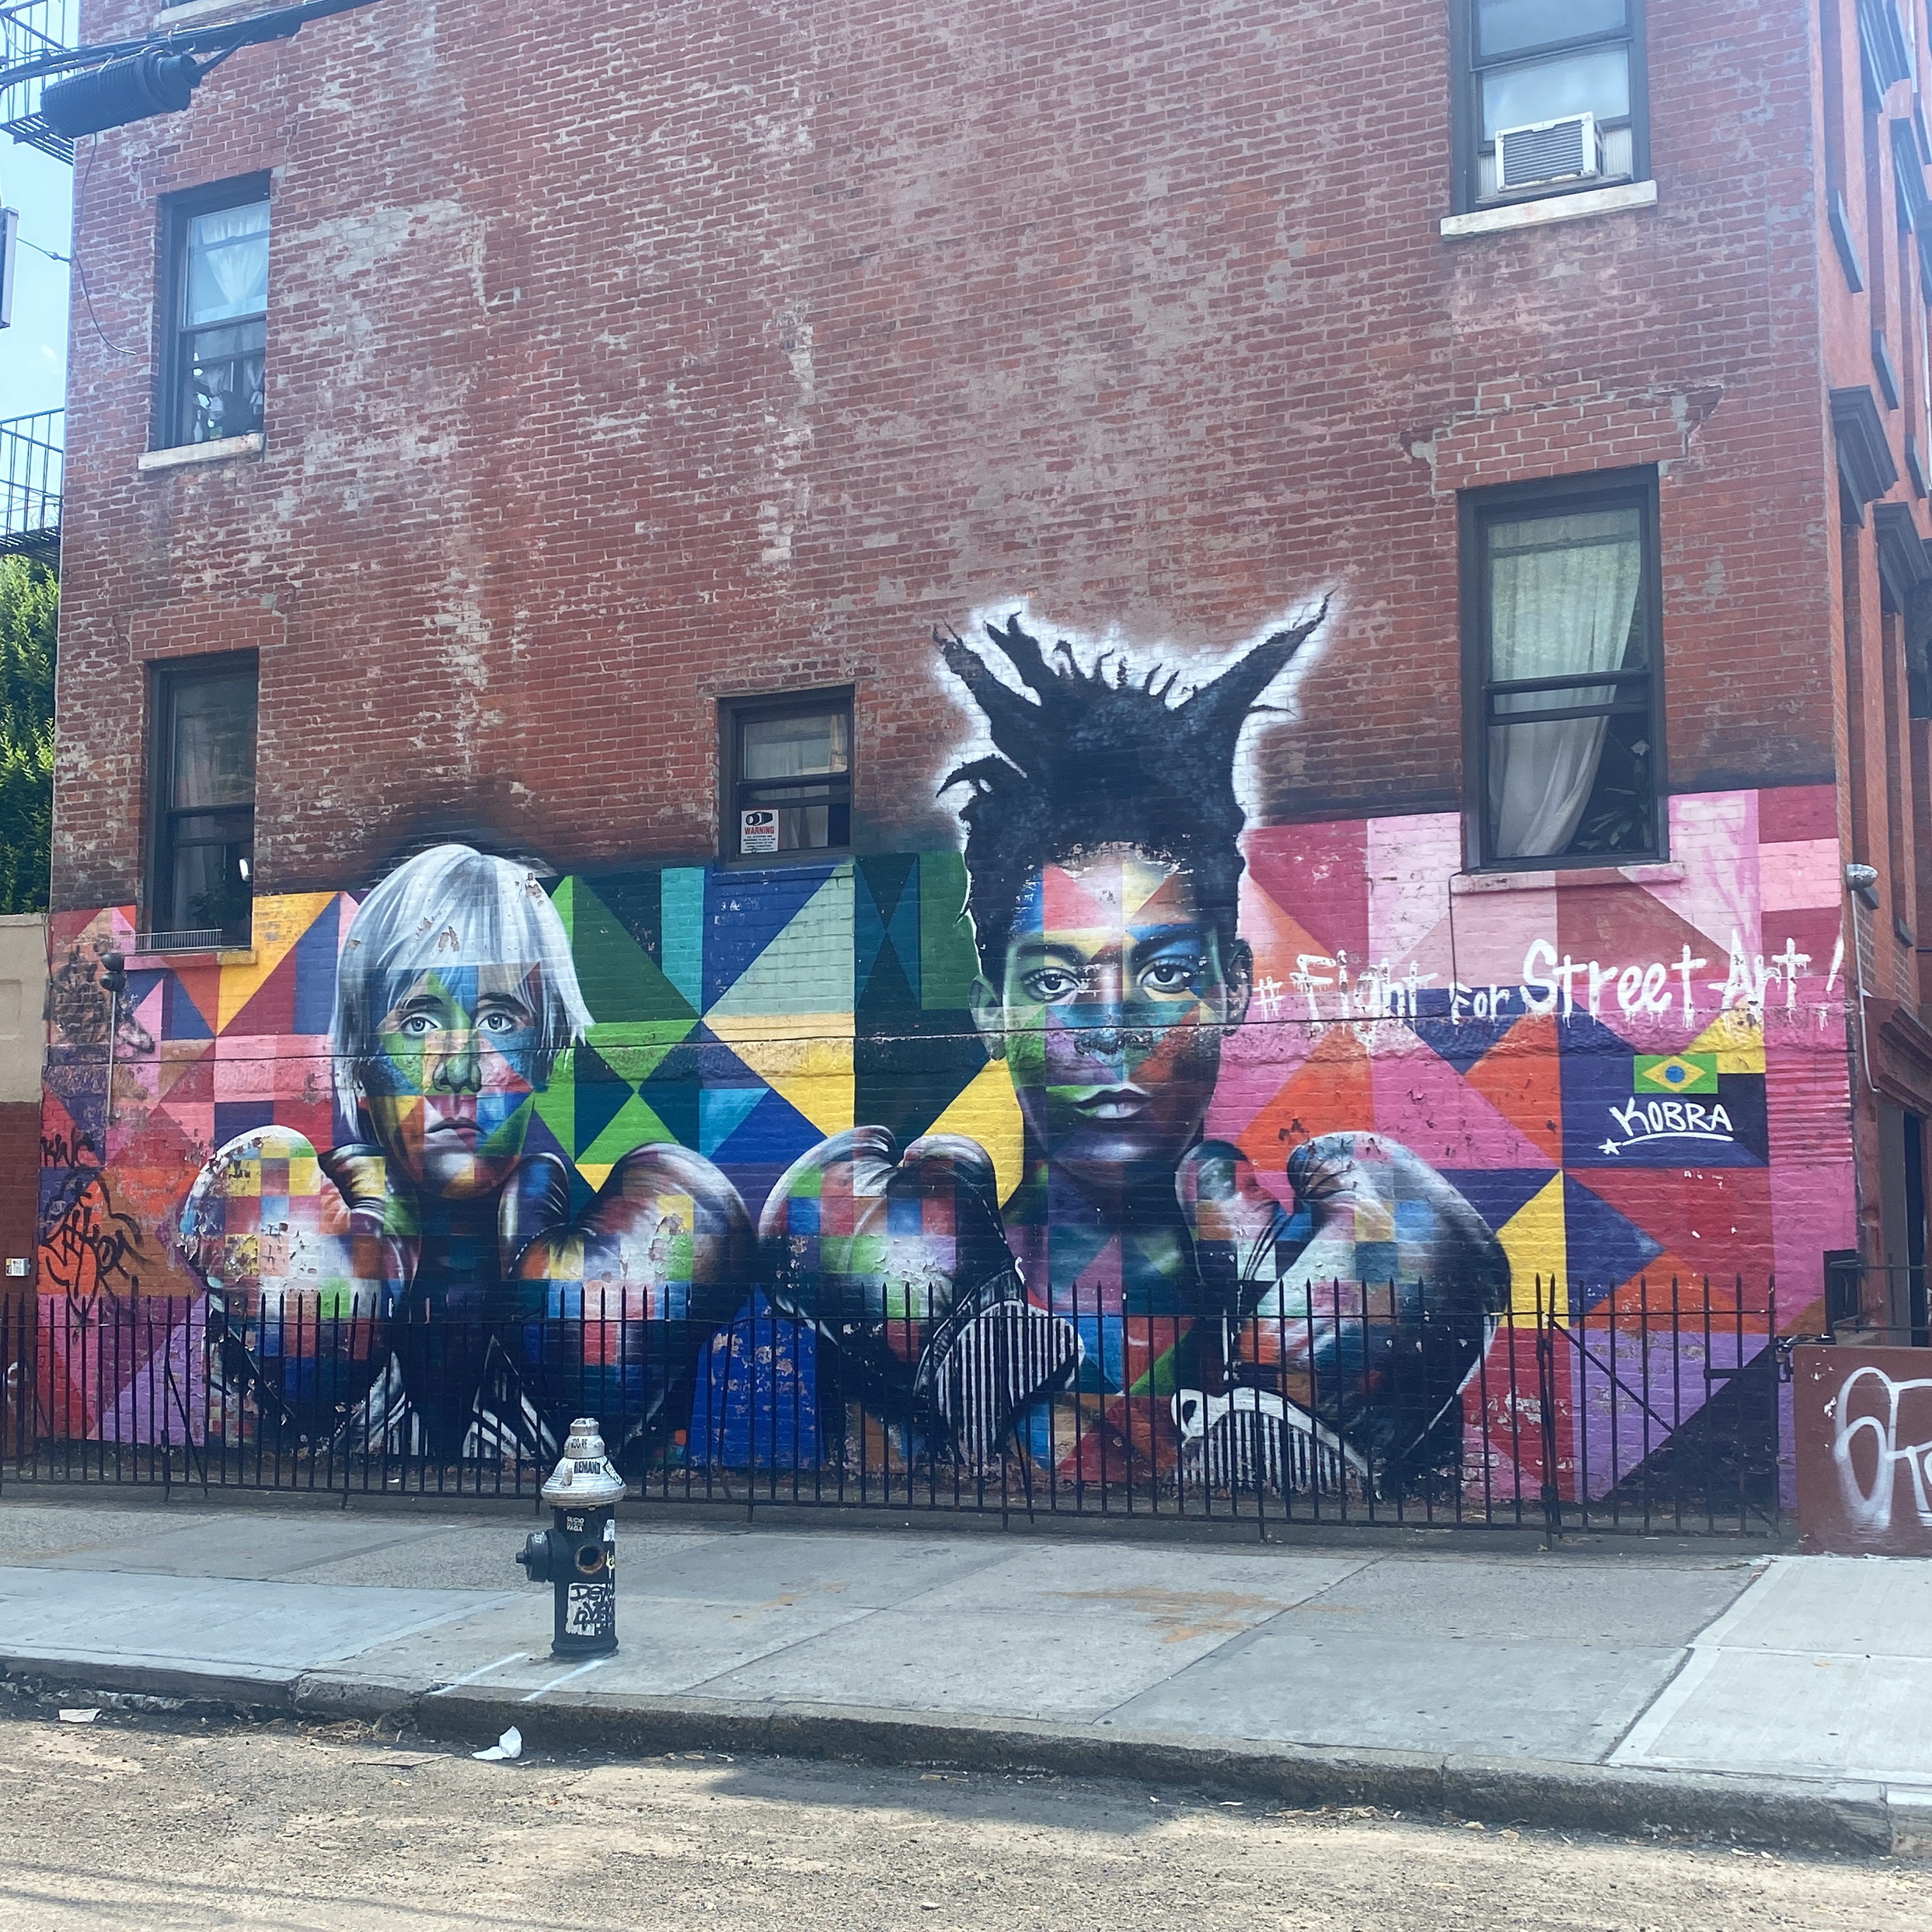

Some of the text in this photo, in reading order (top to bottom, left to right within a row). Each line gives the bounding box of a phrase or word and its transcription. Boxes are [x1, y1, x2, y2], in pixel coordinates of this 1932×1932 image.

[744, 826, 775, 834] WARNING
[1520, 938, 1707, 1029] Street
[1609, 1096, 1733, 1136] KOBRA
